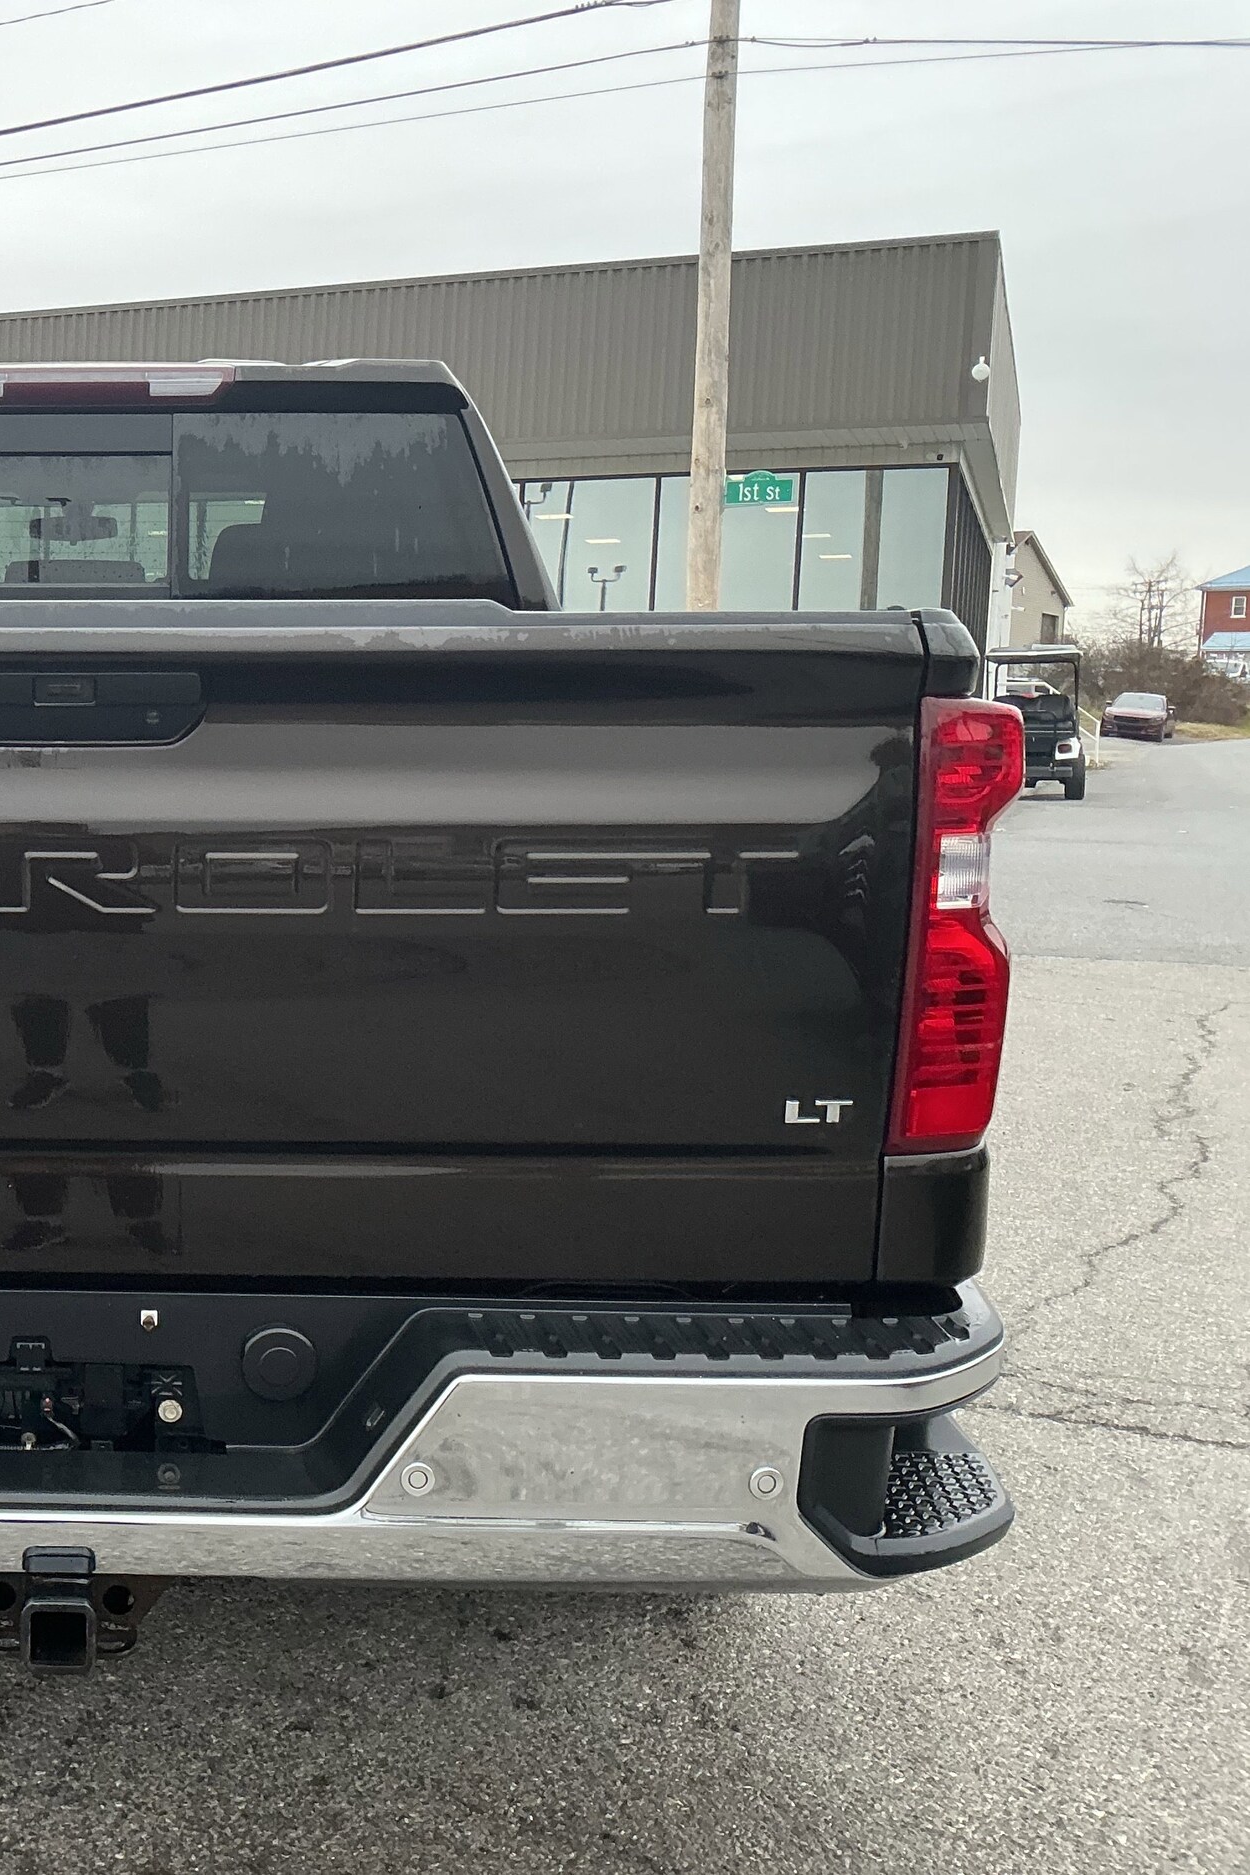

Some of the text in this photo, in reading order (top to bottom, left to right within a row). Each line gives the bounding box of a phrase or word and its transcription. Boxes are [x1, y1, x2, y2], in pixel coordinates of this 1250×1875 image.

[739, 483, 780, 501] 1st St
[785, 1100, 853, 1123] LT
